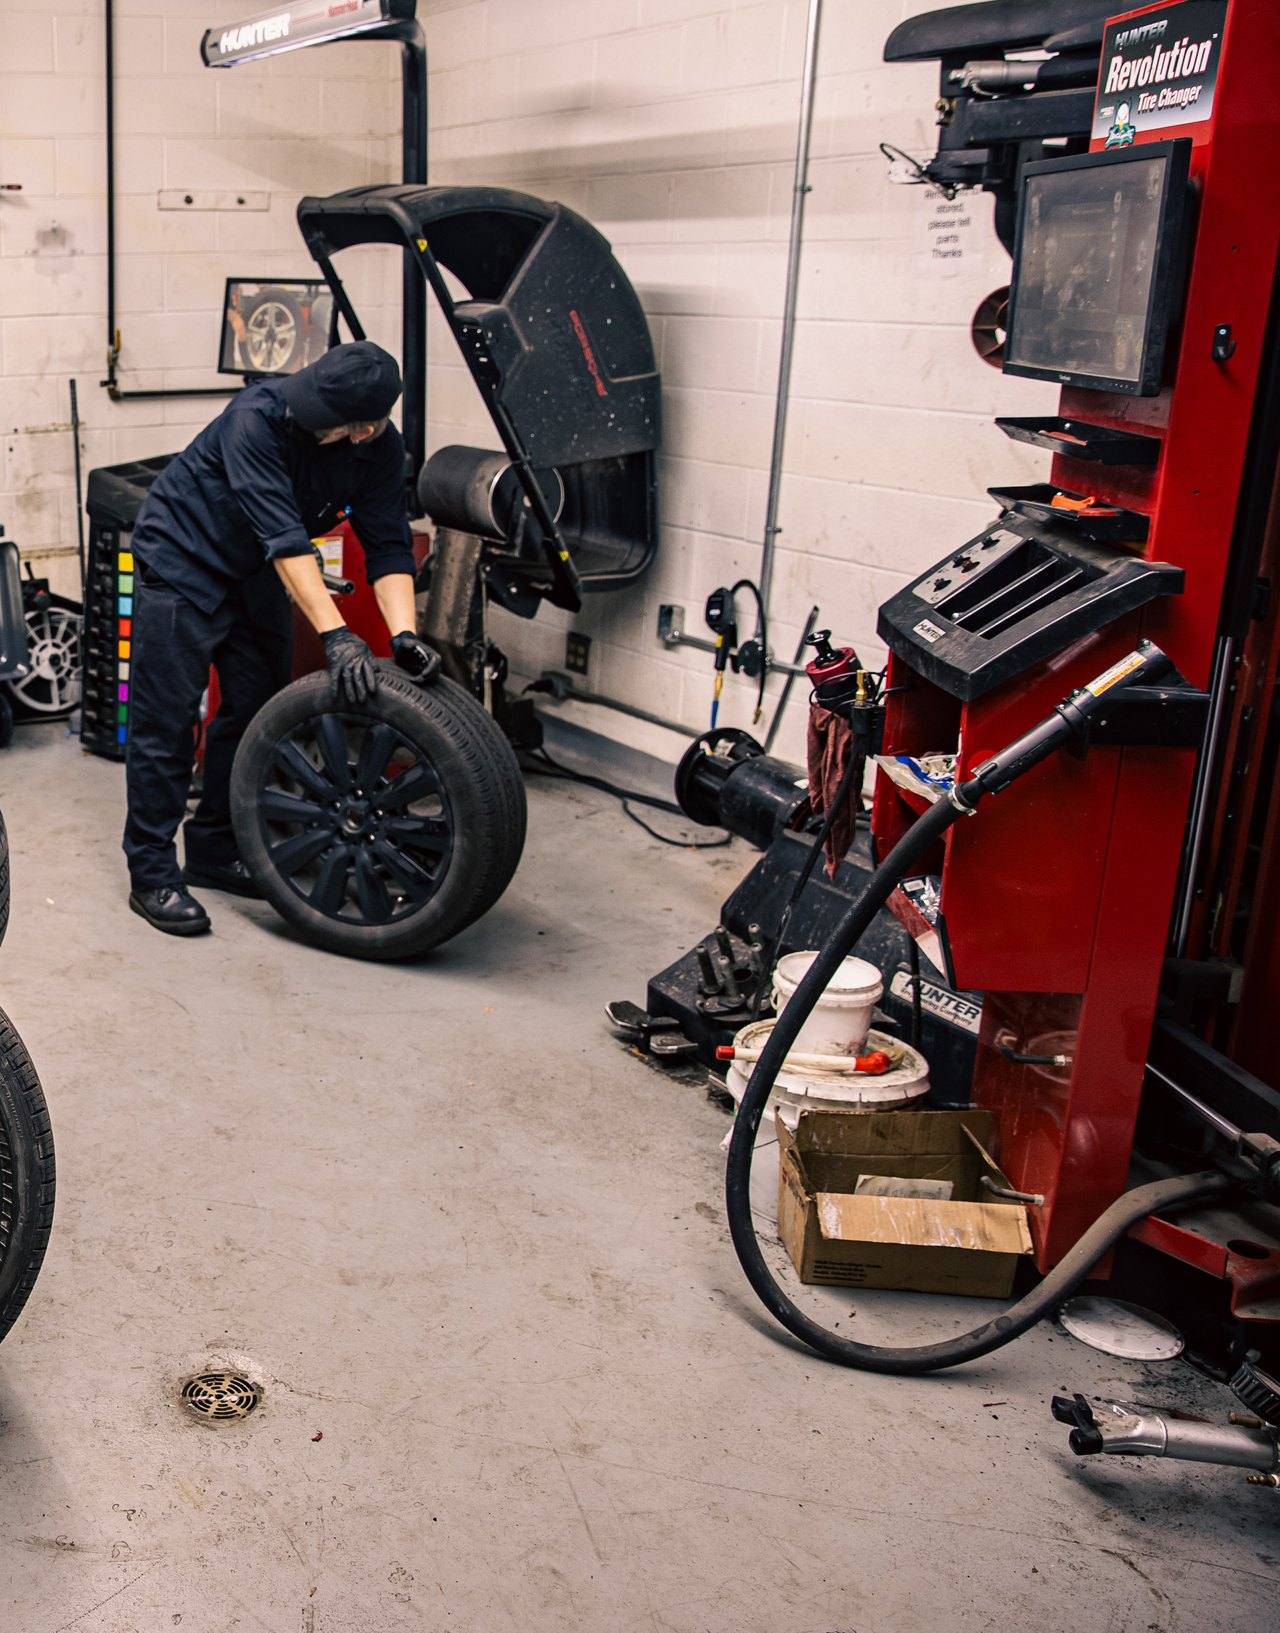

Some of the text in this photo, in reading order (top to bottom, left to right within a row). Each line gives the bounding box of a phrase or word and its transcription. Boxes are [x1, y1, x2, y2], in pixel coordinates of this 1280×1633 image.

[220, 13, 291, 54] HUNTER
[1114, 19, 1168, 48] HUNTER
[1104, 36, 1213, 94] Revolution
[1137, 85, 1202, 112] Tire Changer
[940, 1003, 972, 1027] Company
